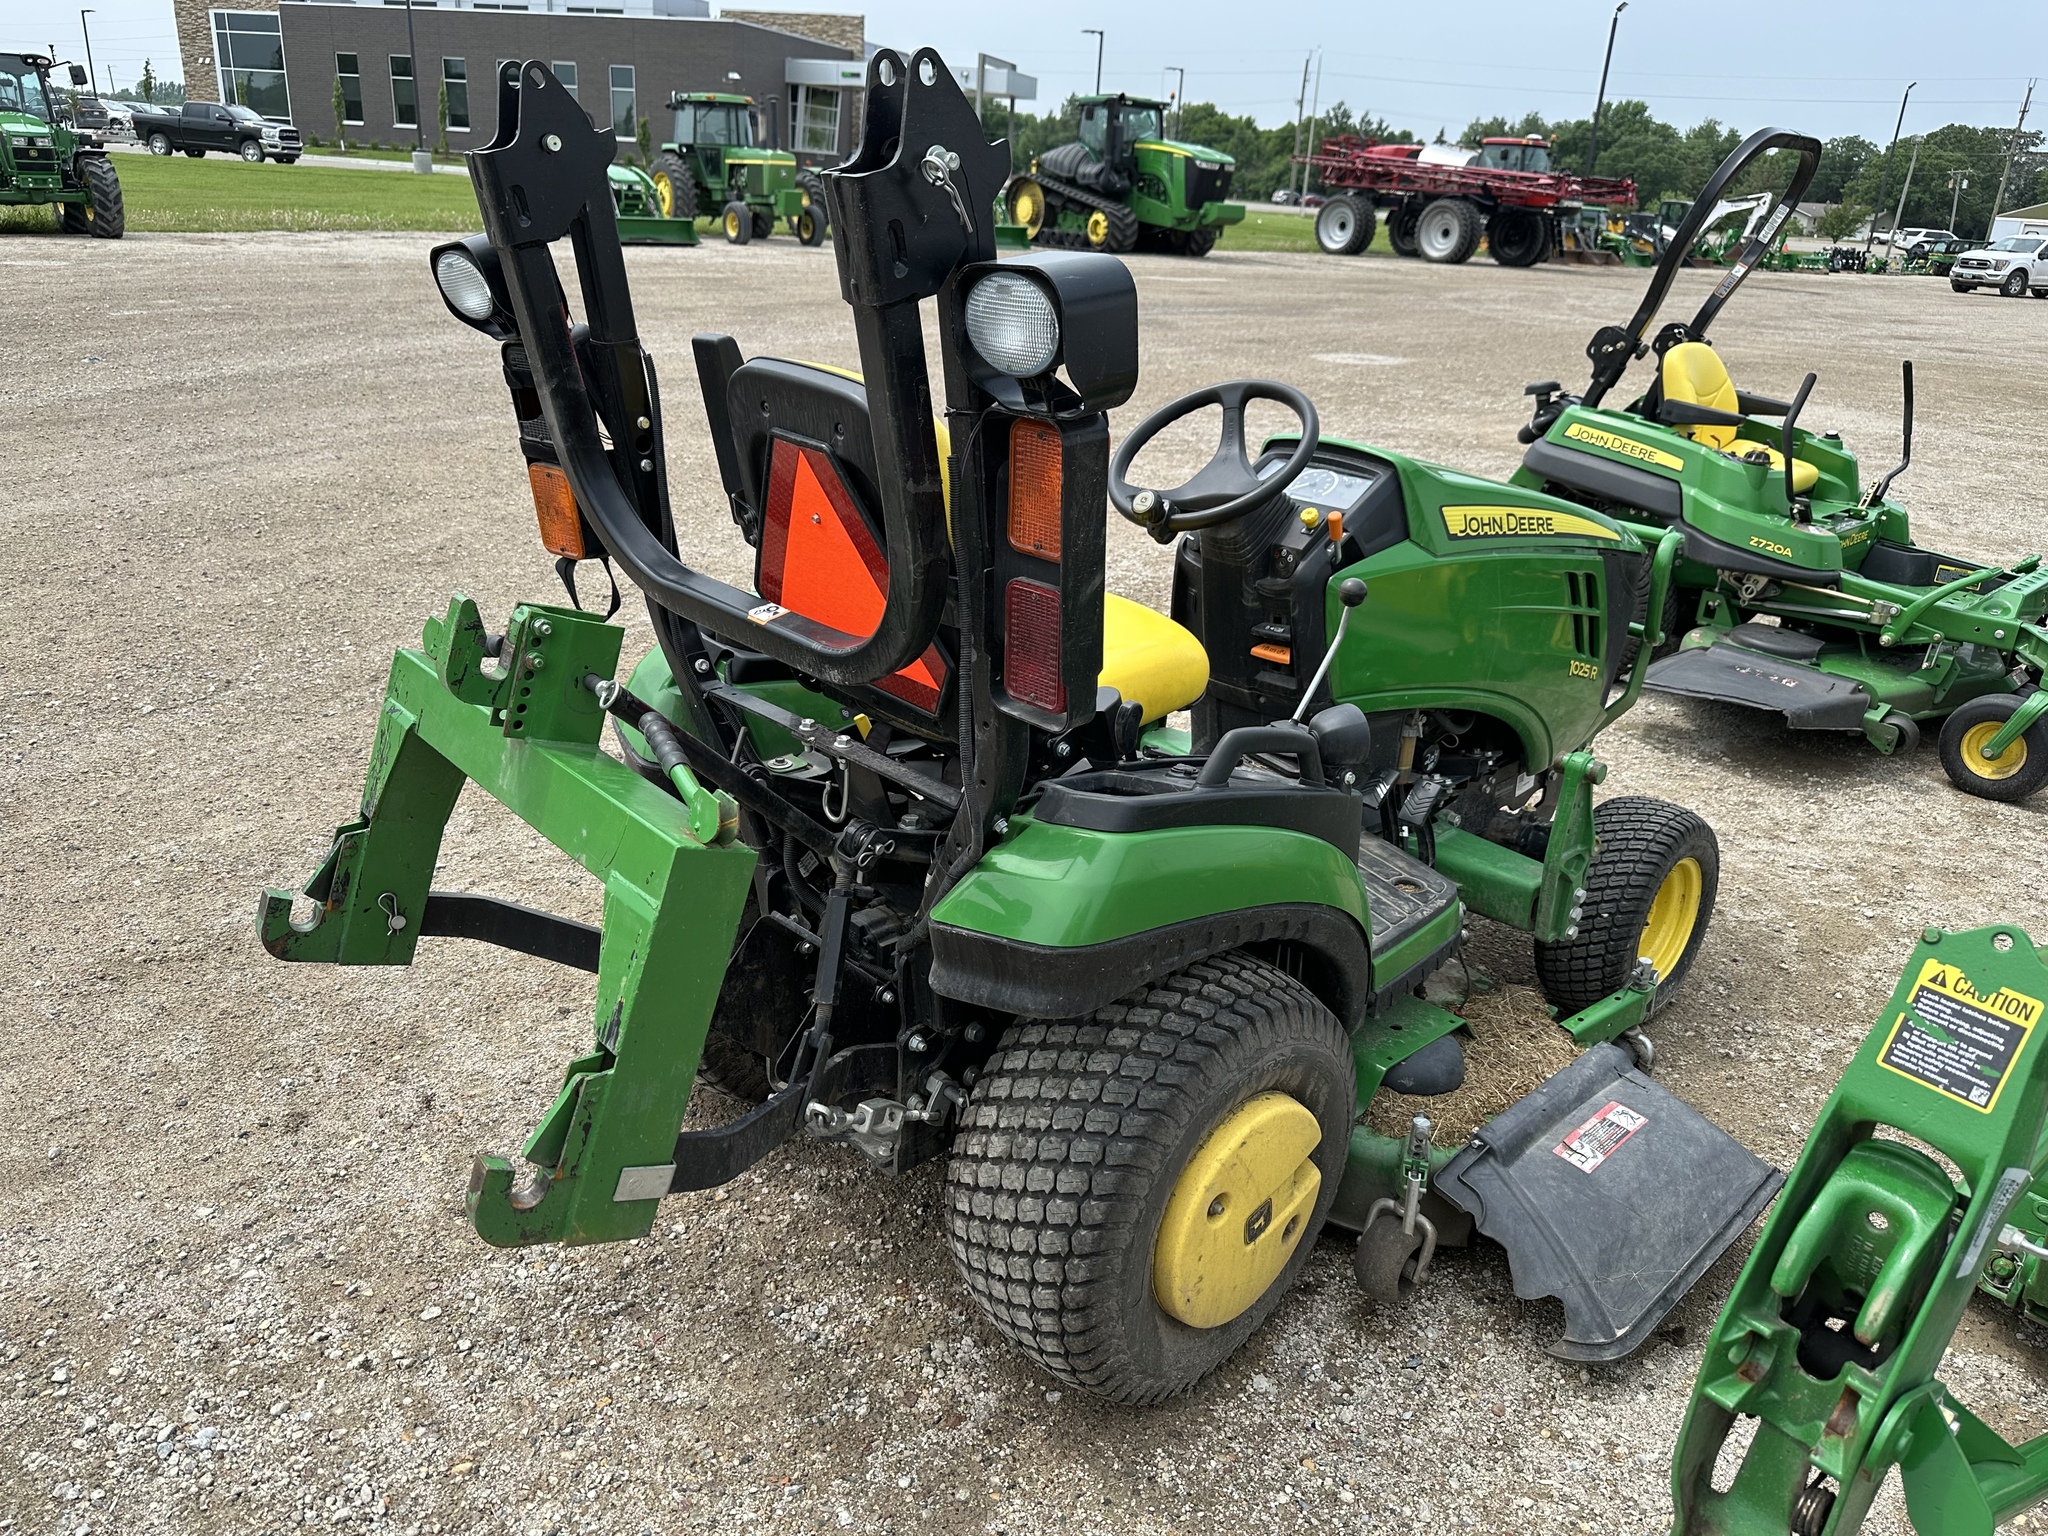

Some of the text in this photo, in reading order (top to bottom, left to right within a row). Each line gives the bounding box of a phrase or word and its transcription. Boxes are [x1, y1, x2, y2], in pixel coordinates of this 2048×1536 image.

[1572, 427, 1657, 461] JOHN DEERE
[1459, 512, 1555, 535] JOHN DEERE
[1749, 535, 1793, 558] Z720A
[1849, 530, 1870, 546] DEERE
[1922, 990, 1940, 1002] Lock
[1961, 1006, 1987, 1021] latches
[1986, 1017, 2010, 1031] before
[1914, 1008, 1949, 1027] equipment
[1957, 1027, 2005, 1052] disconnecting
[1916, 1001, 1939, 1015] Before
[1971, 1026, 2005, 1044] adjusting
[1893, 1048, 1910, 1060] tions
[1896, 1042, 1923, 1059] Observe
[1923, 1055, 1945, 1069] safety
[1906, 1040, 1937, 1058] hydraulic
[1910, 1034, 1927, 1046] Shut
[1936, 1047, 1960, 1061] engine
[1967, 1046, 1994, 1060] ground
[1890, 1055, 1923, 1073] operator's
